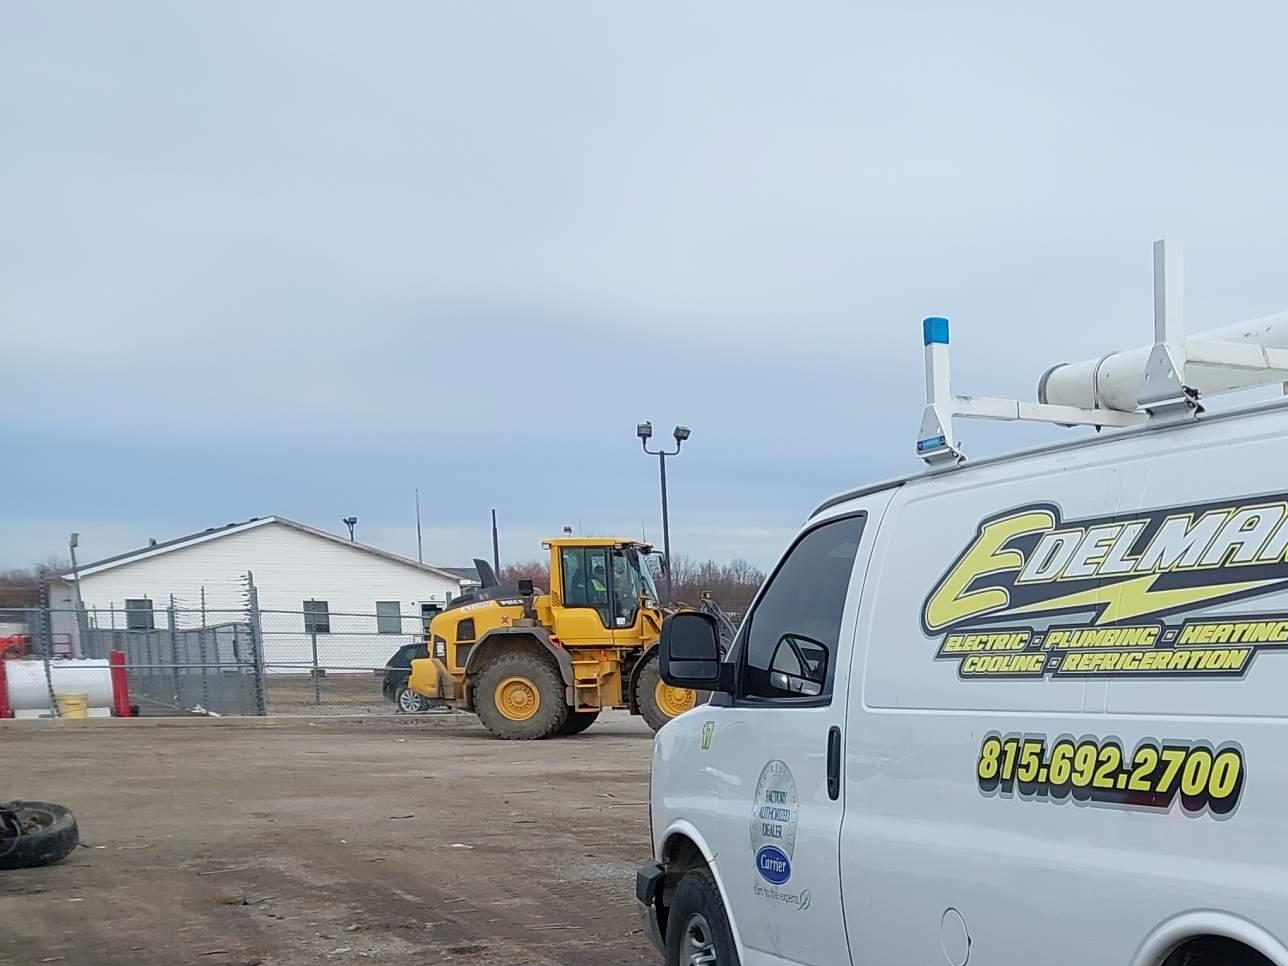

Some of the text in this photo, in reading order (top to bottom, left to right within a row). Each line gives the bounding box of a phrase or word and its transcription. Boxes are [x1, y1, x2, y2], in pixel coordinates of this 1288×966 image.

[944, 633, 1029, 652] ELECTRIC
[1045, 627, 1159, 649] PLUMBING
[963, 649, 1249, 672] COOLING REFRIGERATION
[978, 738, 1242, 801] 815.692.2700
[765, 789, 788, 805] FACTORY
[762, 823, 783, 839] DEALER
[760, 854, 787, 873] Carrier
